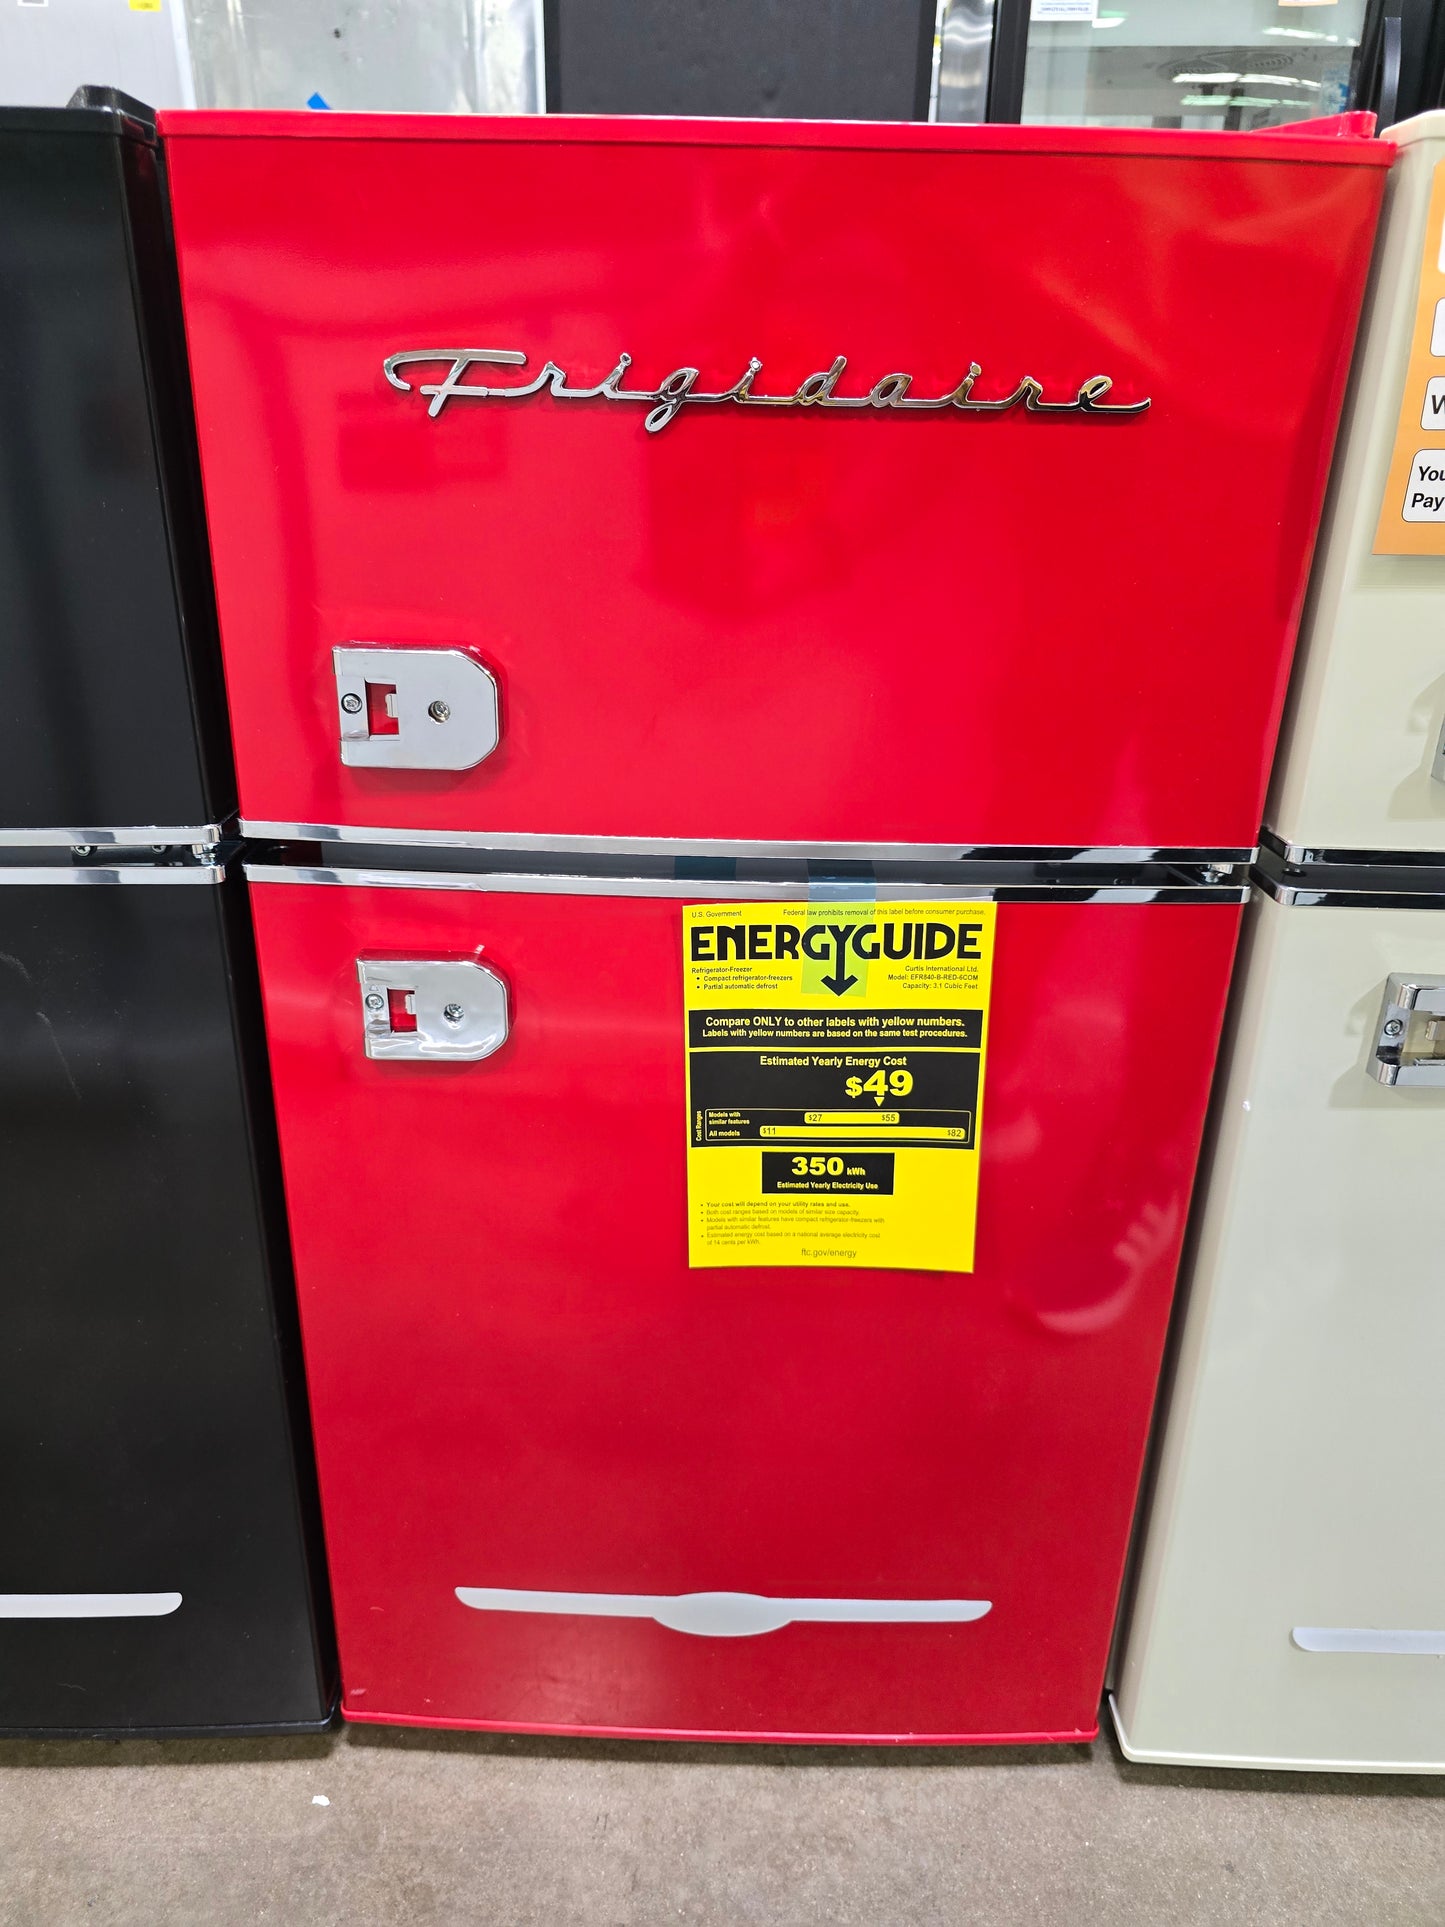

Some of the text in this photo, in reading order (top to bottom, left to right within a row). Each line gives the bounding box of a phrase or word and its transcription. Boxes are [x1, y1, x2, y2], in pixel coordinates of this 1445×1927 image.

[384, 349, 1151, 433] Frigidaire
[1411, 493, 1445, 512] Pay
[818, 909, 843, 917] prohibits
[870, 908, 876, 916] of
[956, 908, 985, 916] purchase.
[690, 923, 983, 962] ENERGYGUIDE
[733, 975, 792, 983] refrigerator-freezers
[706, 1016, 965, 1028] Compare ONLY to other labels with yellow numbers.
[703, 1029, 728, 1037] Labels
[730, 1029, 747, 1037] with
[749, 1029, 773, 1038] yellow
[776, 1029, 810, 1037] numbers
[827, 1029, 851, 1037] based
[865, 1029, 877, 1037] the
[903, 1029, 918, 1037] test
[920, 1029, 968, 1038] procedures.
[760, 1056, 907, 1068] Estimated Yearly Energy Cost
[845, 1070, 914, 1098] $49
[808, 1114, 822, 1122] $27
[882, 1114, 896, 1122] $55
[763, 1127, 776, 1135] $11
[947, 1129, 961, 1138] $82
[792, 1156, 866, 1176] 350 kWh
[811, 1182, 830, 1190] Yearly
[832, 1182, 864, 1190] Electricity
[802, 1248, 857, 1258] ftc.gov/energy
